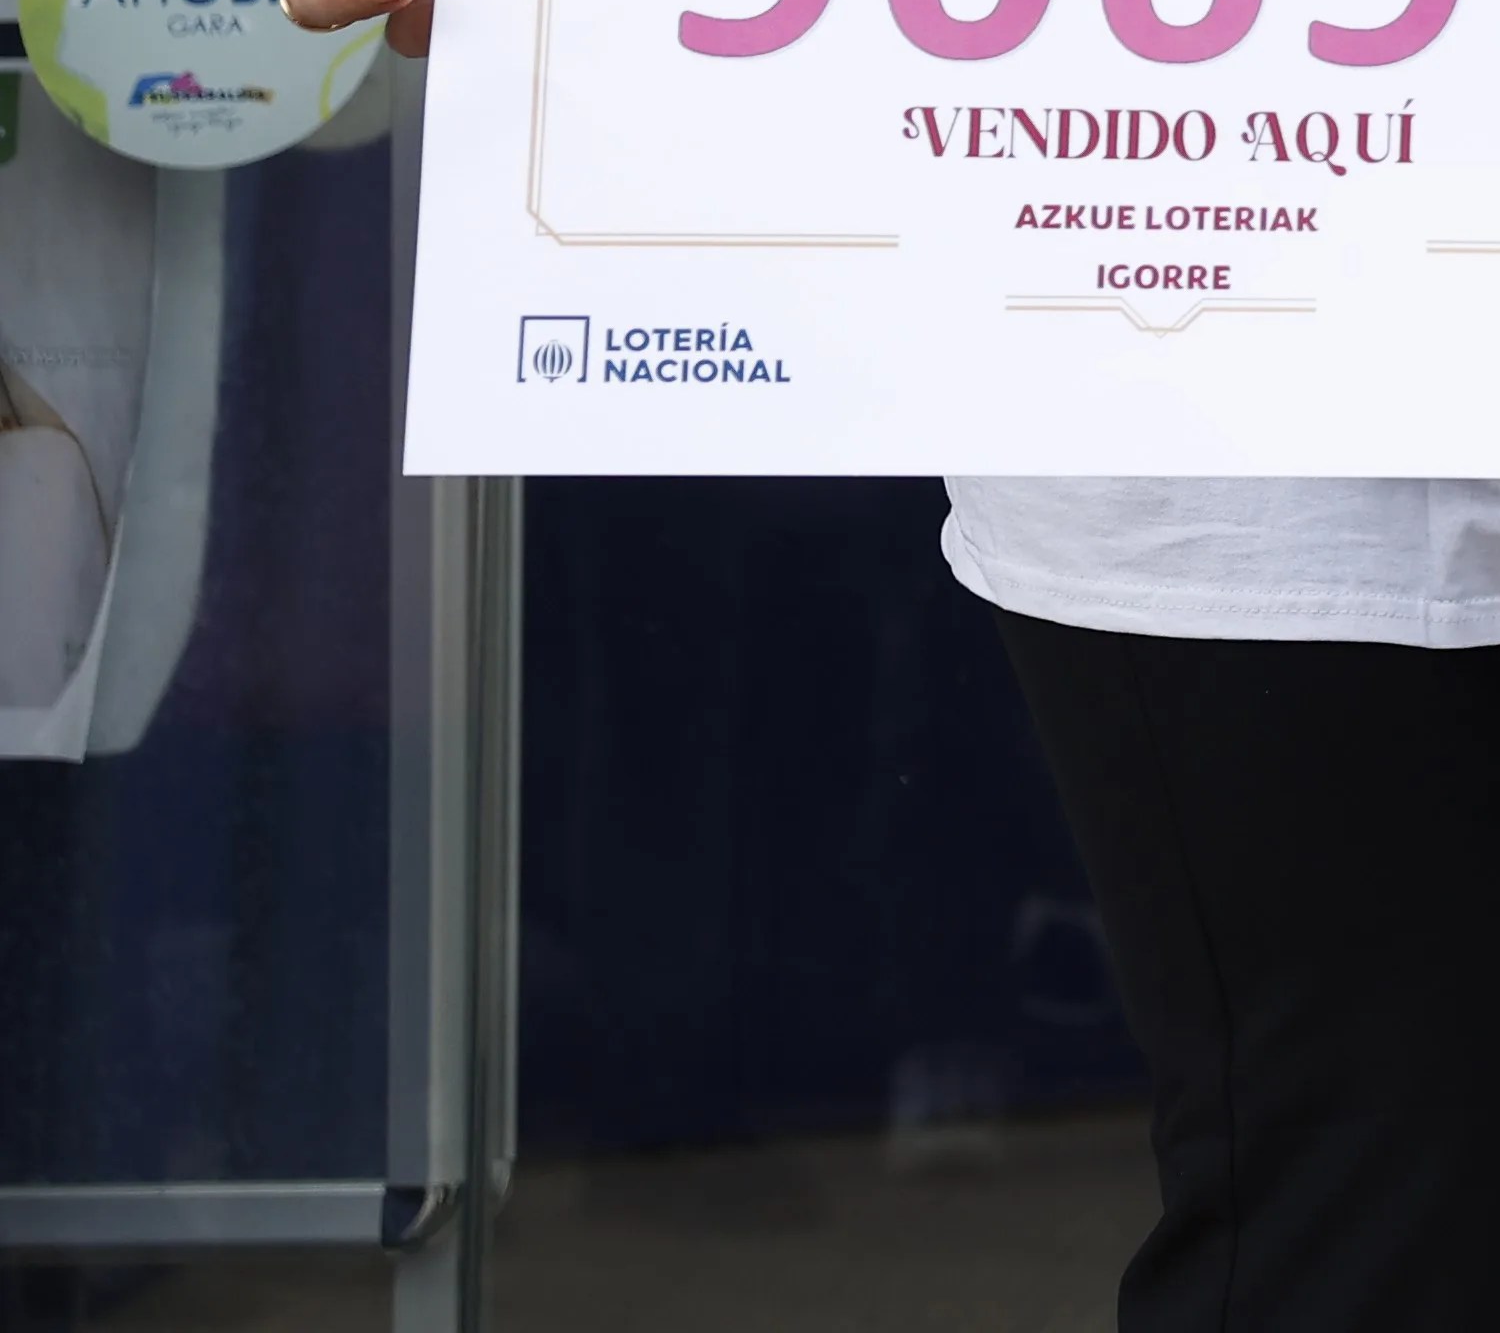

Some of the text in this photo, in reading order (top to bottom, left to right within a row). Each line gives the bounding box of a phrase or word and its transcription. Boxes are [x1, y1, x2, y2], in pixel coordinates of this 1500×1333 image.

[167, 14, 245, 36] GARA
[902, 98, 1416, 177] VENDIDO AQUÍ
[1014, 203, 1319, 233] AZKUE LOTERIAK
[1096, 263, 1232, 291] IGORRE
[605, 322, 754, 353] LOTERÍA
[604, 358, 791, 384] NACIONAL
